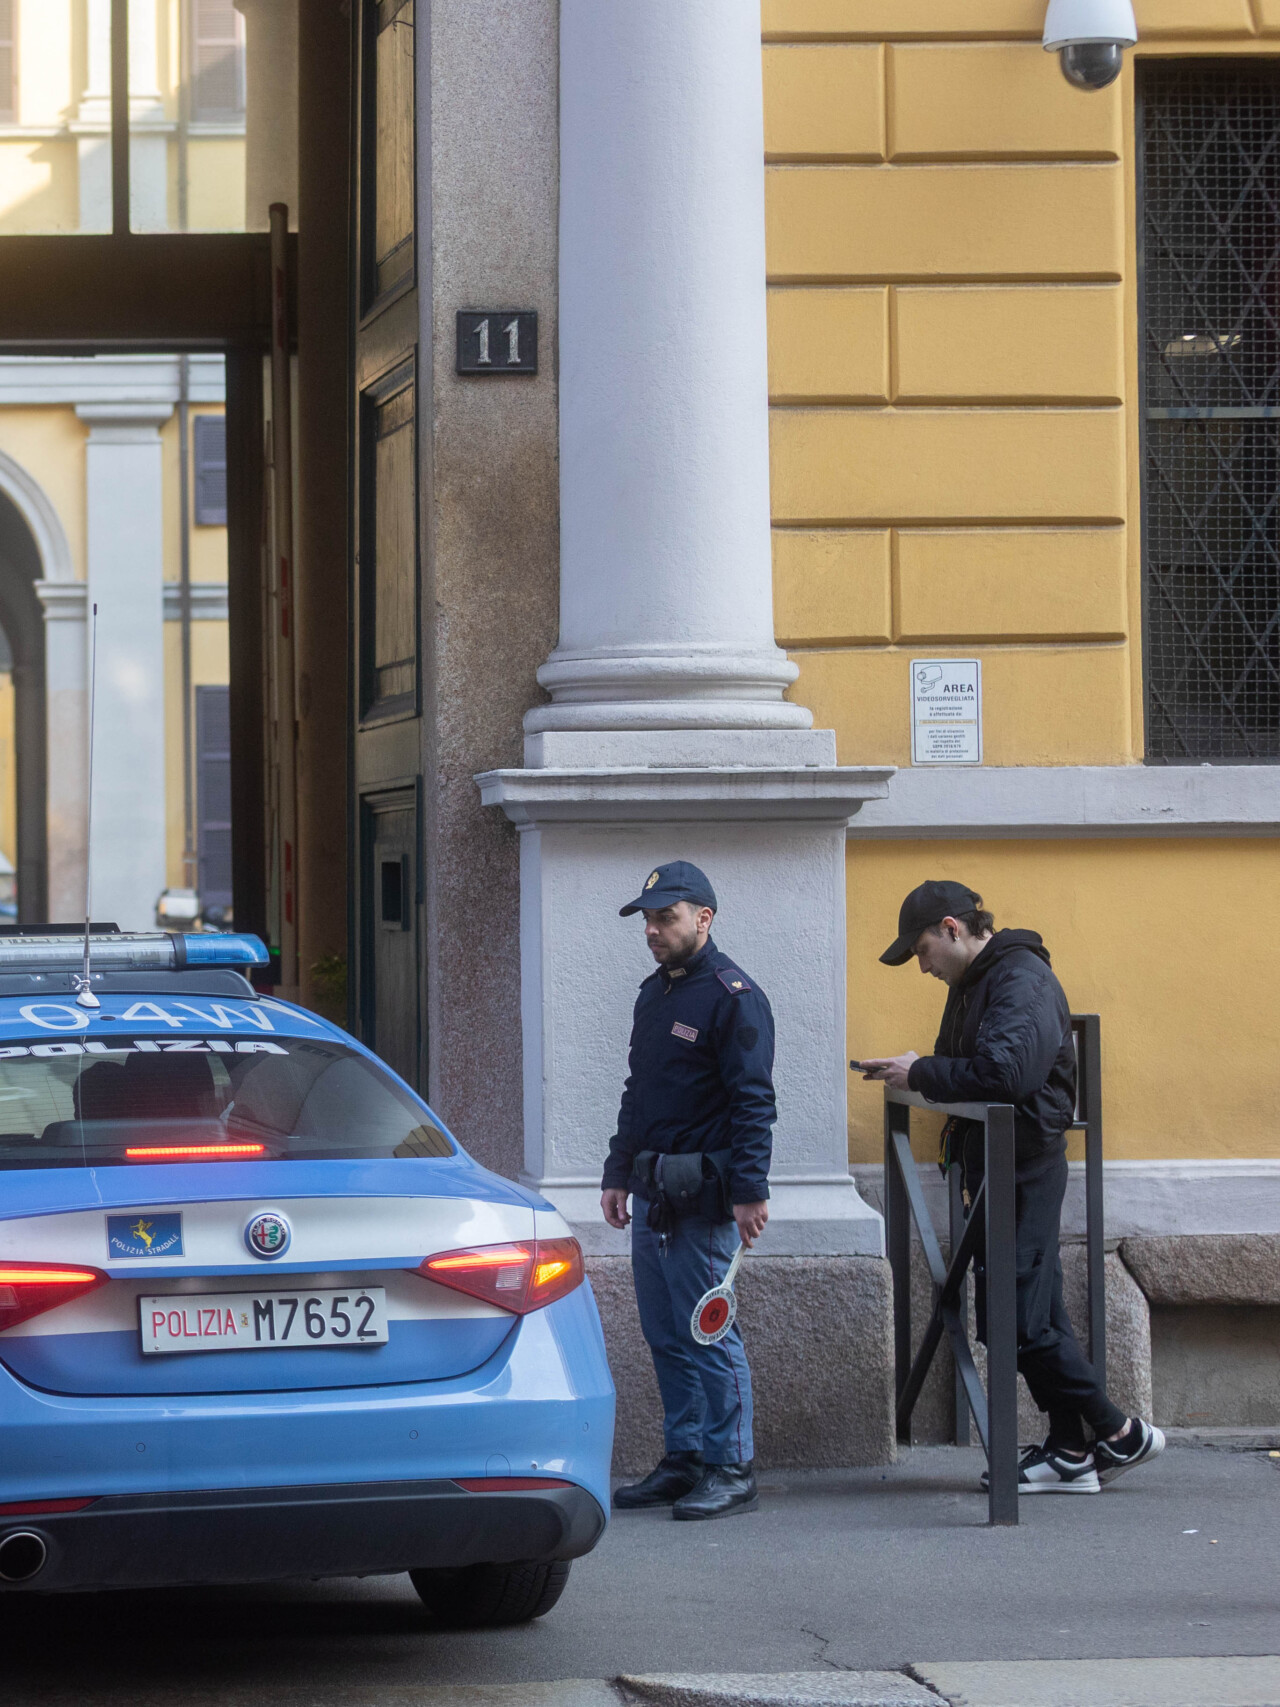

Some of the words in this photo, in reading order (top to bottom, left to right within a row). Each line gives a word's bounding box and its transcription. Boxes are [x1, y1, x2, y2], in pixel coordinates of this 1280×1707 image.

[473, 319, 521, 364] 11
[943, 684, 974, 693] AREA
[674, 1025, 696, 1039] POLIZIA
[111, 1237, 144, 1256] POLIZIA
[147, 1233, 180, 1256] STRADALE
[152, 1308, 237, 1338] POLIZIA
[253, 1296, 377, 1341] M7652
